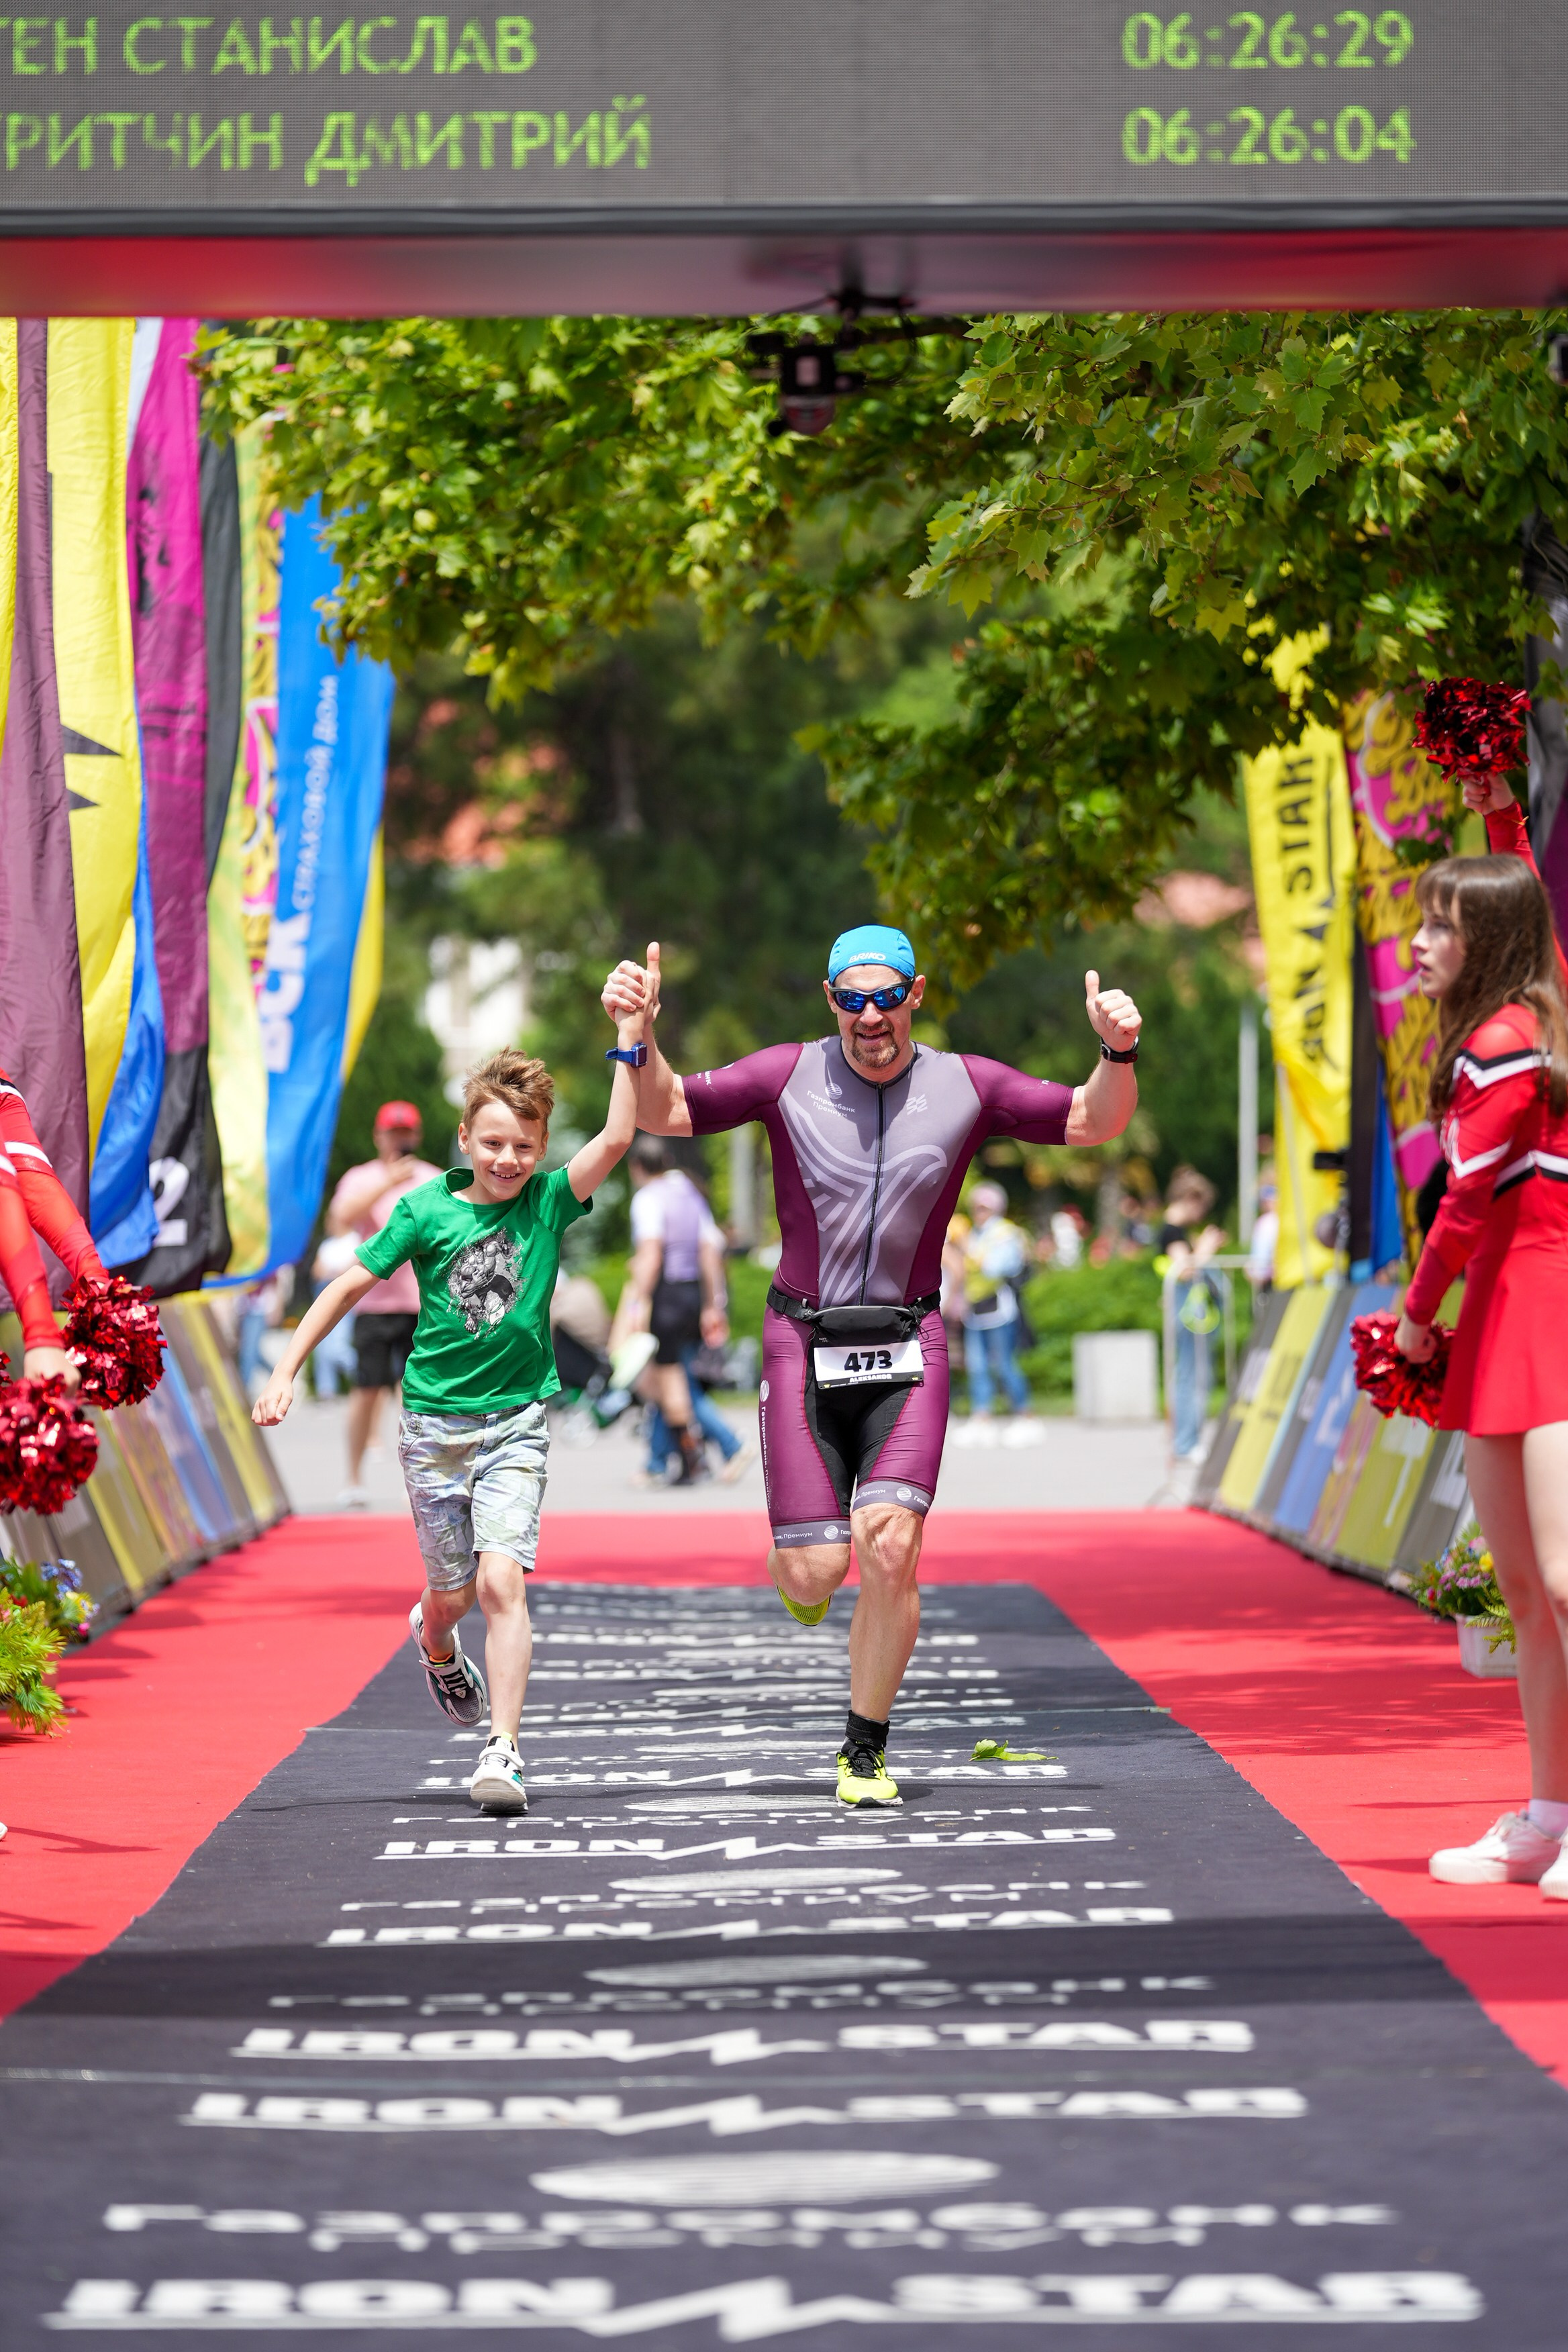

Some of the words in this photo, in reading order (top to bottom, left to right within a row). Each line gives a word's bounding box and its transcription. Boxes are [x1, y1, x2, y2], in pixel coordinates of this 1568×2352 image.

[122, 16, 538, 75] СТАНИСЛАВ
[1121, 9, 1414, 69] 06:26:29
[0, 112, 283, 171] РИТЧИН
[304, 94, 652, 187] ДМИТРИЙ
[1121, 105, 1417, 165] 06:26:04
[847, 951, 886, 964] BRIKO
[807, 1090, 856, 1113] Газпромбанк
[813, 1101, 848, 1118] Премиум
[844, 1350, 893, 1373] 473
[849, 1373, 893, 1383] ALEKSANDR
[861, 1489, 887, 1498] Премиум
[391, 1806, 1095, 1824] Газпромбанк
[505, 1816, 985, 1829] Премиум
[383, 1839, 665, 1855] IRON
[816, 1827, 1117, 1847] STAR
[328, 1921, 653, 1944] IRON
[826, 1906, 1175, 1931] STAR
[243, 2028, 634, 2055] IRON
[838, 2019, 1254, 2051] STAR
[190, 2092, 624, 2125] IRON
[846, 2086, 1309, 2118] STAR
[62, 2275, 618, 2320] IRON
[892, 2270, 1482, 2317] STAR
